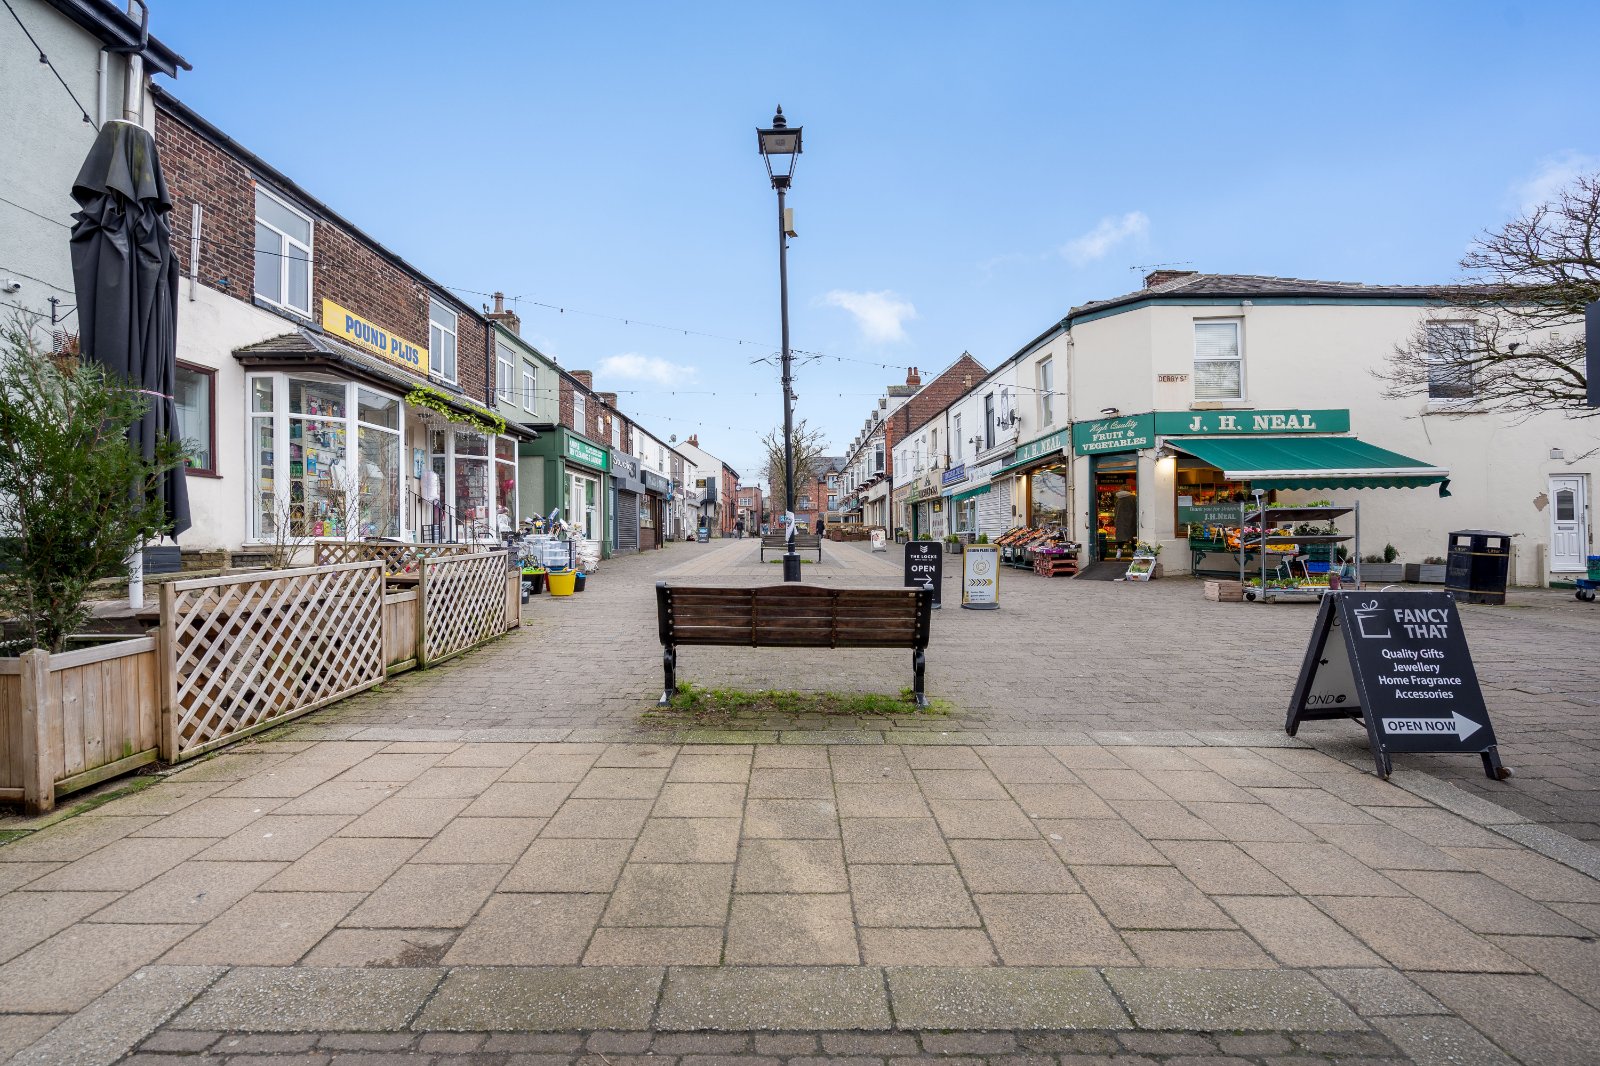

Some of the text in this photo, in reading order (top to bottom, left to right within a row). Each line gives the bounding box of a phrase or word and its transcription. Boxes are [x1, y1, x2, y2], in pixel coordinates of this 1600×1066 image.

[345, 314, 387, 350] POUND
[390, 337, 419, 365] PLUS
[1090, 418, 1138, 434] High Quality
[1189, 414, 1316, 432] J. H. NEAL
[1092, 430, 1124, 442] FRUIT
[1024, 436, 1060, 458] J. H. NEAL
[1082, 436, 1146, 450] VEGETABLES
[1394, 608, 1448, 622] FANCY
[1404, 624, 1448, 638] THAT
[1382, 649, 1444, 660] Quality Gifts
[1394, 662, 1440, 674] Jewellery
[1378, 676, 1462, 687] Home Fragrance
[1306, 694, 1335, 705] OND
[1396, 689, 1454, 699] Accessories
[1388, 722, 1456, 731] OPEN NOW
